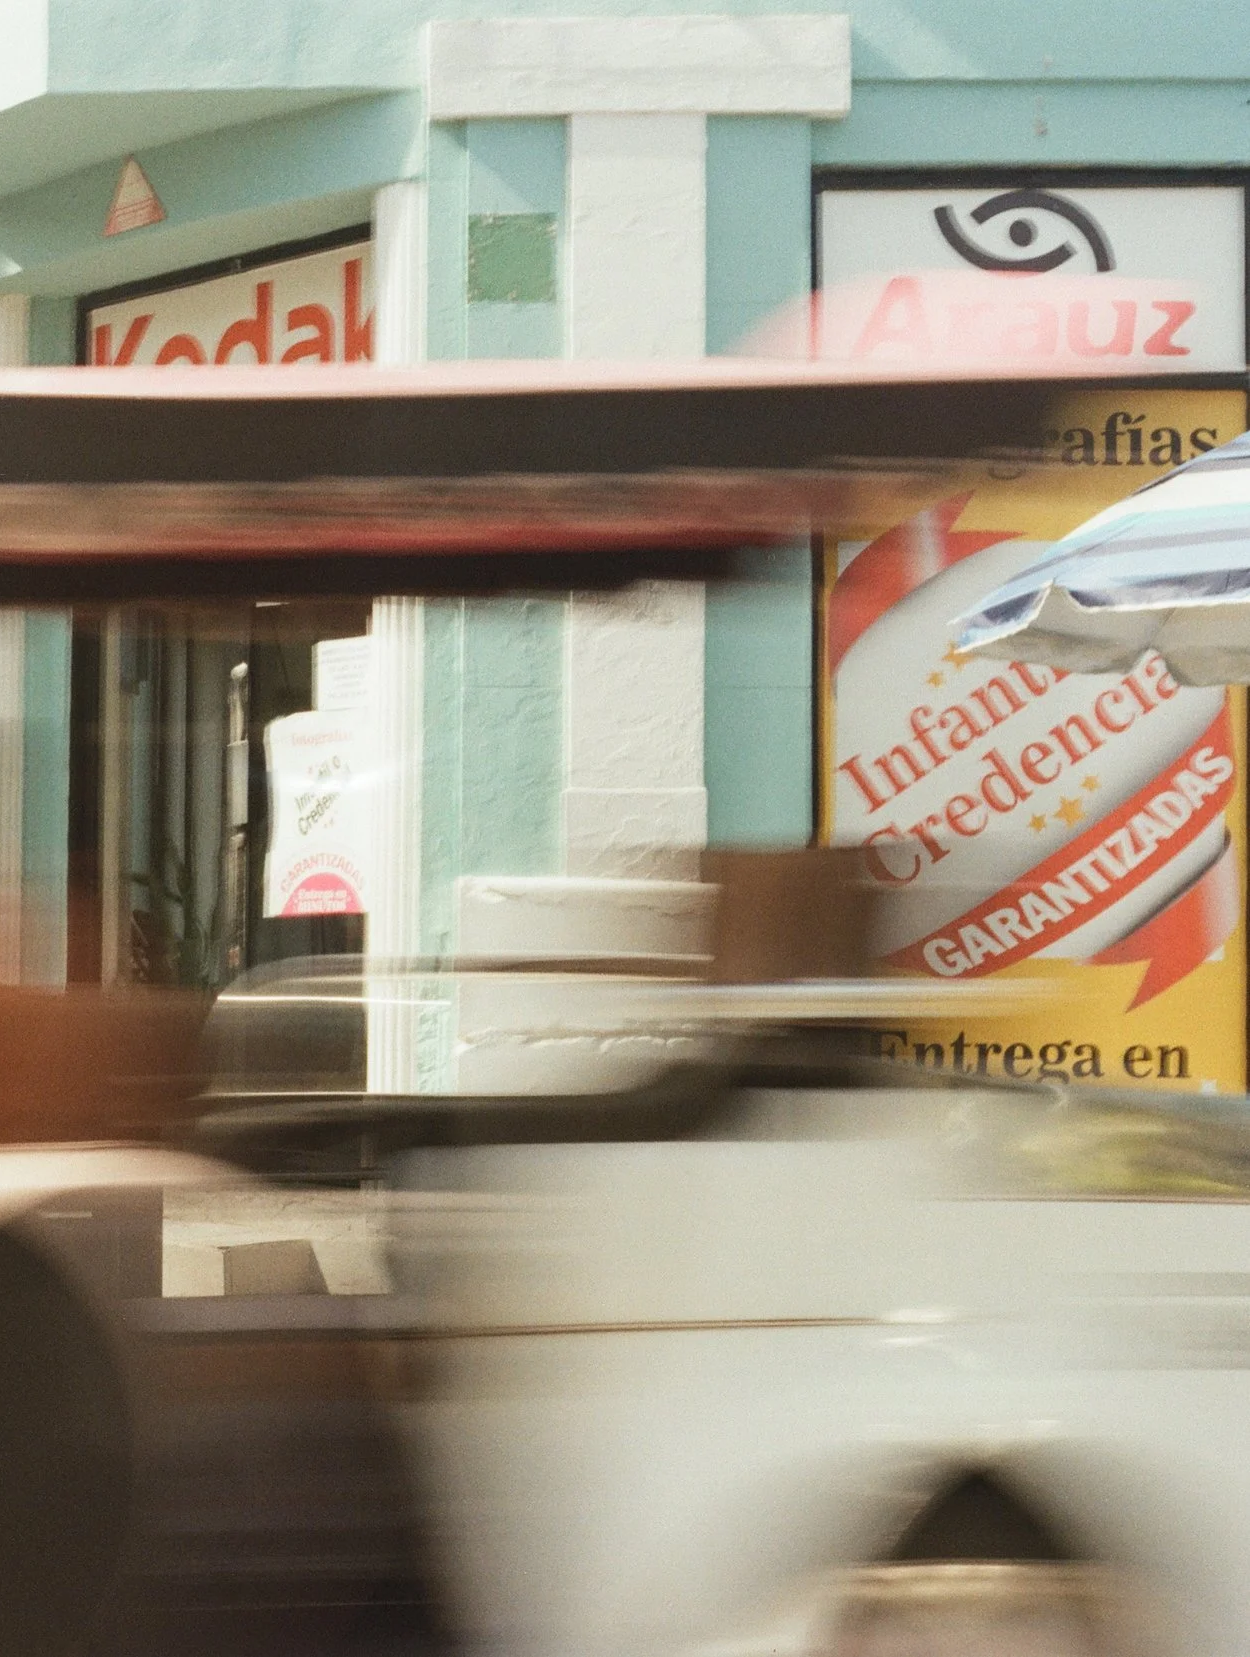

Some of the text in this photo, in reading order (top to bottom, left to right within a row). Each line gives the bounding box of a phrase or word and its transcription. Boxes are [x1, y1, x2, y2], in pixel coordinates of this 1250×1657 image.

[95, 257, 376, 366] Kodak
[852, 275, 1197, 361] Arauz
[922, 746, 1234, 978] GARANTIZADAS
[872, 1030, 1190, 1084] Entrega en
